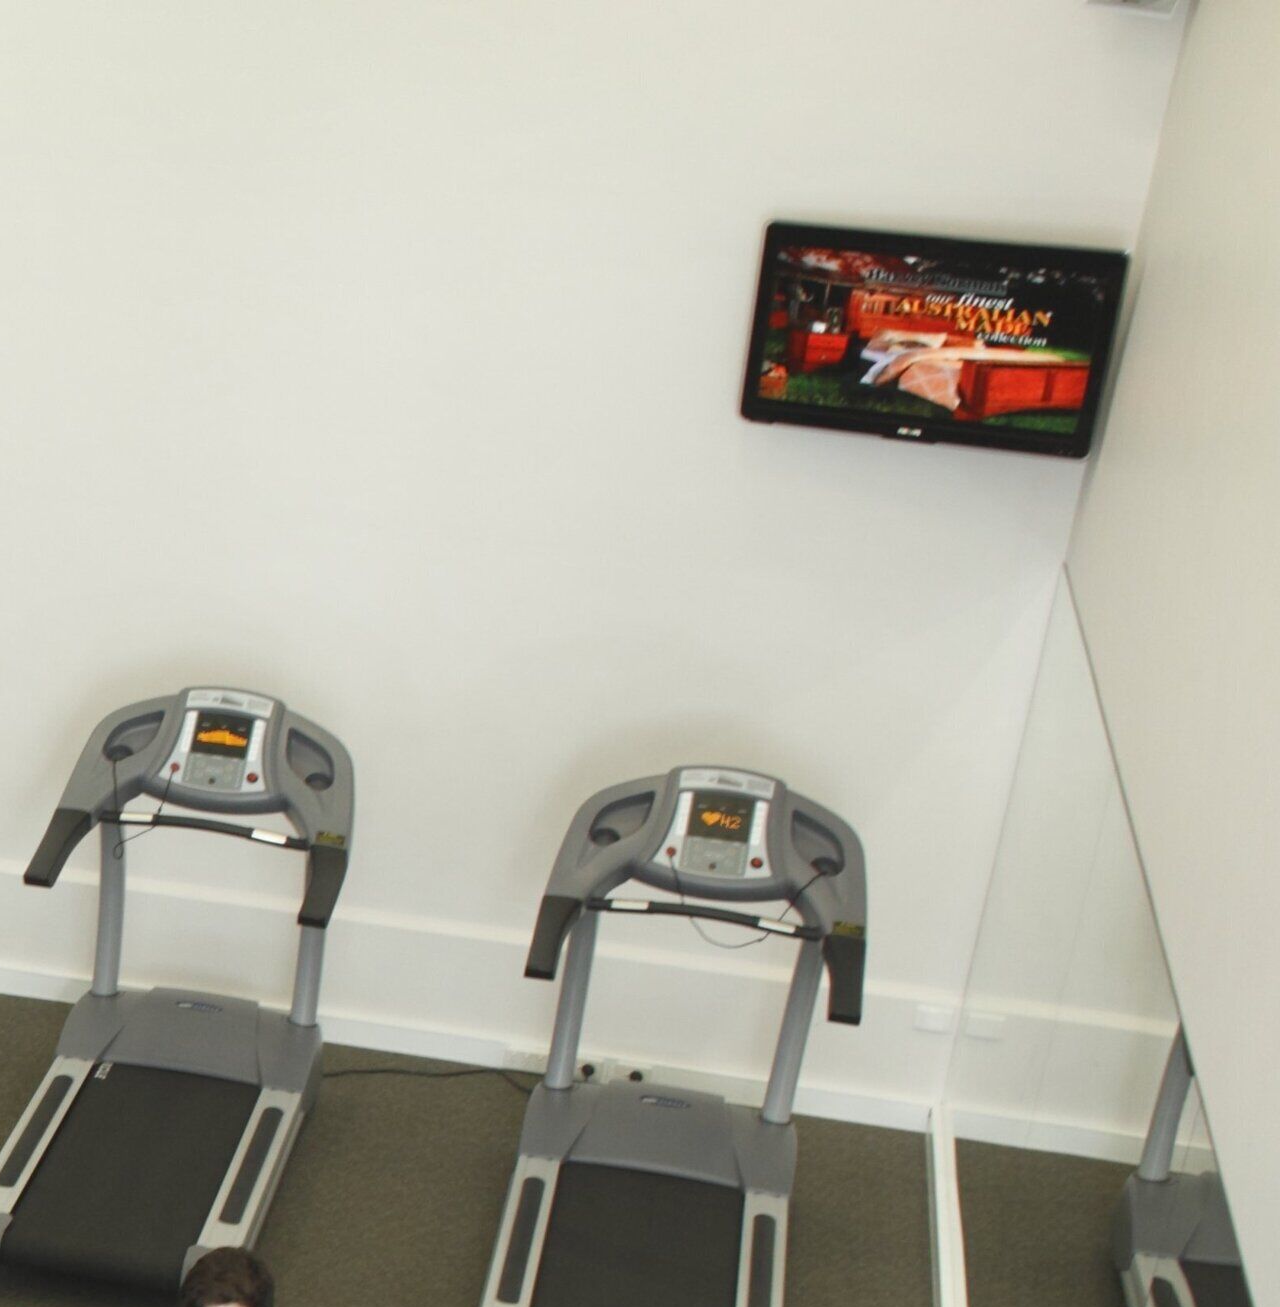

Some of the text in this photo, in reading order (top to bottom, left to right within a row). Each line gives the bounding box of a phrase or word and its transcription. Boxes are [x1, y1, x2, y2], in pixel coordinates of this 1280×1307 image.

[955, 291, 1015, 311] finest
[895, 299, 1053, 328] AUSTRALIAN
[977, 331, 1048, 347] collection
